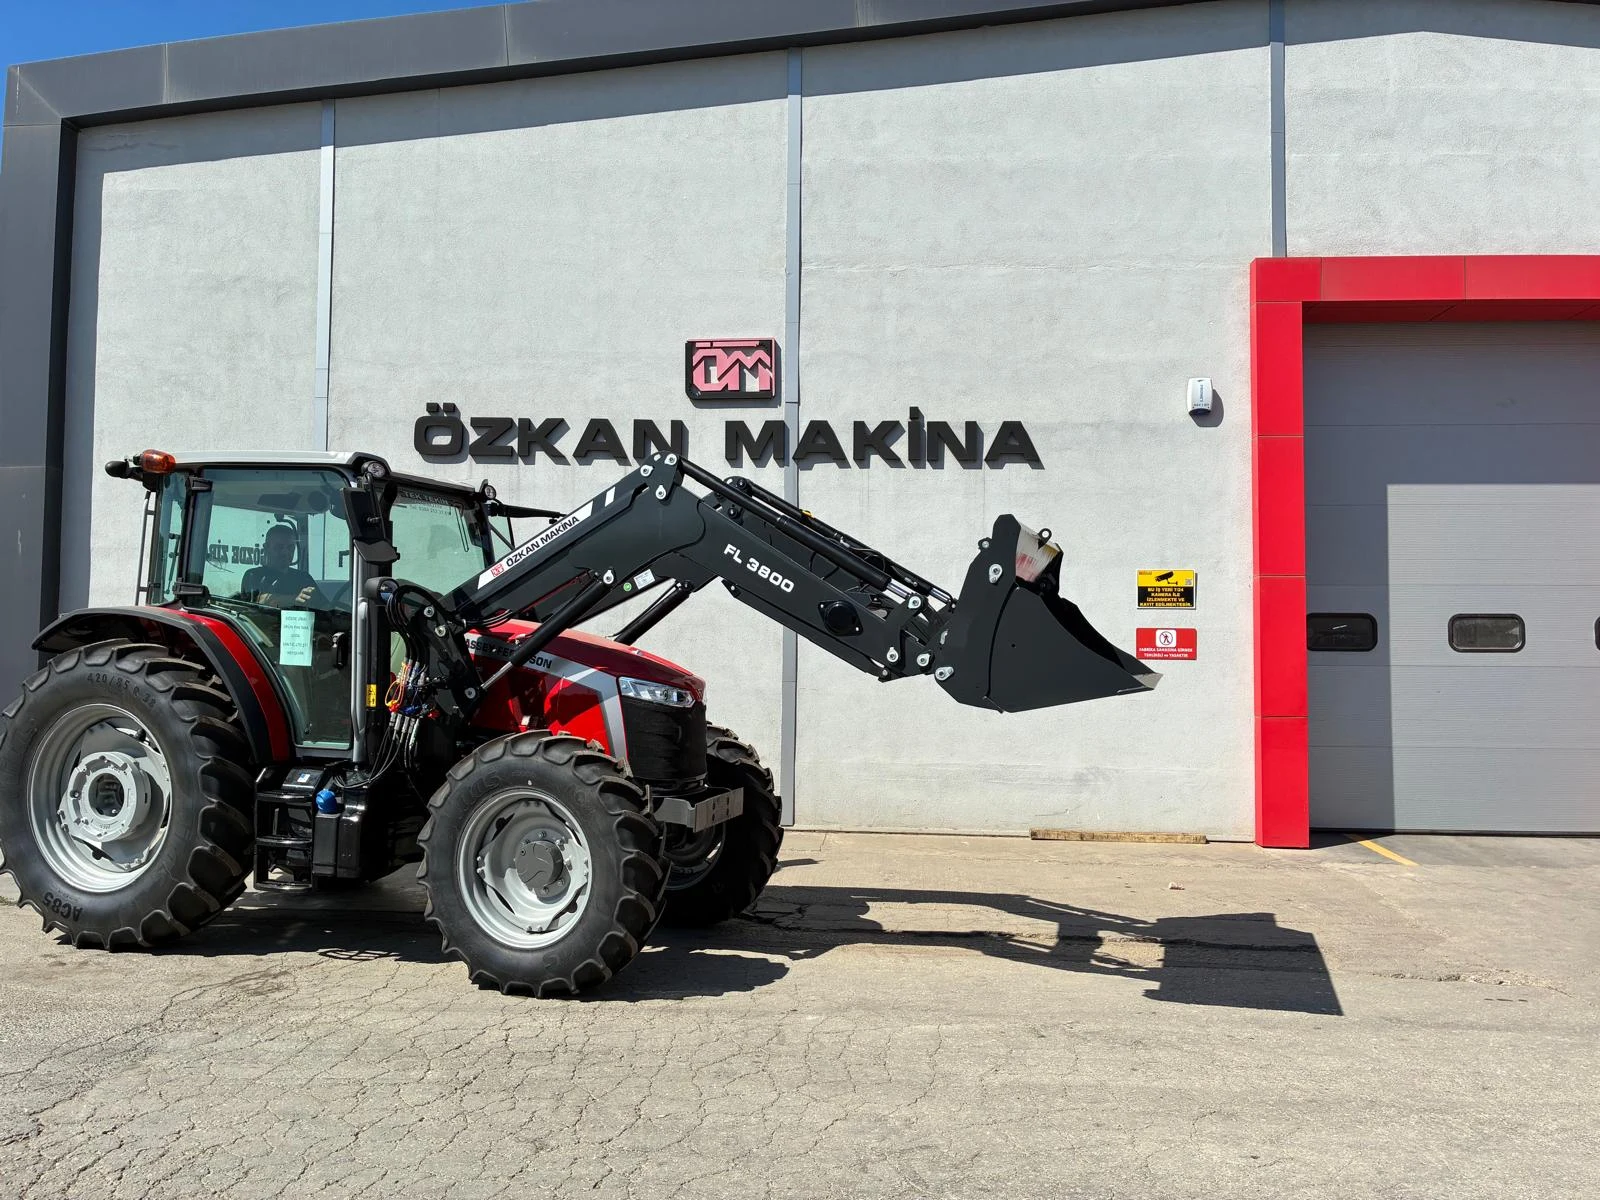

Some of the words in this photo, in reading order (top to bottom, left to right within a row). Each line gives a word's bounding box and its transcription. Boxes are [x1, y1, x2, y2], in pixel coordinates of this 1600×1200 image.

[414, 402, 686, 460] ÖZKAN
[725, 406, 1042, 466] MAKİNA
[506, 541, 540, 567] ÖZKAN
[540, 516, 580, 546] MAKİNA
[723, 543, 743, 564] FL
[746, 557, 795, 593] 3800
[465, 638, 497, 654] ASSEY
[42, 891, 83, 922] AC85
